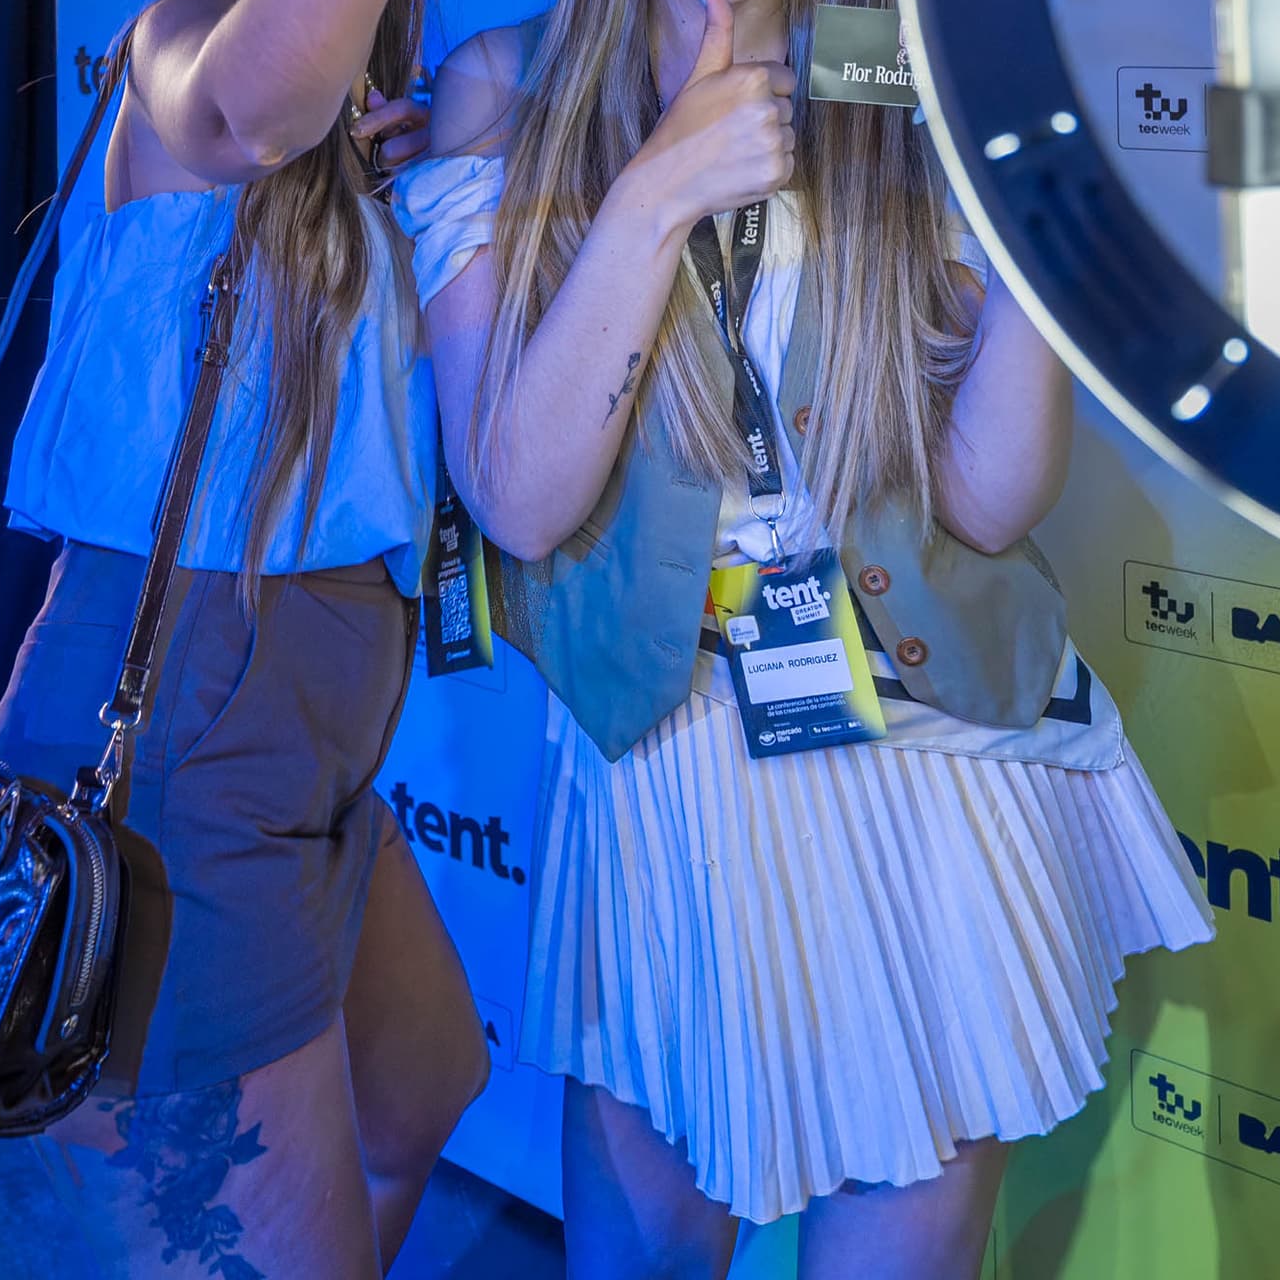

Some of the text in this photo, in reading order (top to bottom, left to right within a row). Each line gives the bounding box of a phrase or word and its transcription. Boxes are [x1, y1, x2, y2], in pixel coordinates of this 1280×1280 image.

[842, 63, 872, 83] Flor
[1139, 124, 1191, 136] tecweek
[741, 204, 760, 246] tent.
[762, 575, 831, 610] tent.
[1145, 620, 1198, 641] tecweek
[747, 652, 839, 674] LUCIANA RODRIGUEZ
[390, 782, 526, 886] tent.
[1152, 1111, 1204, 1139] tecweek
